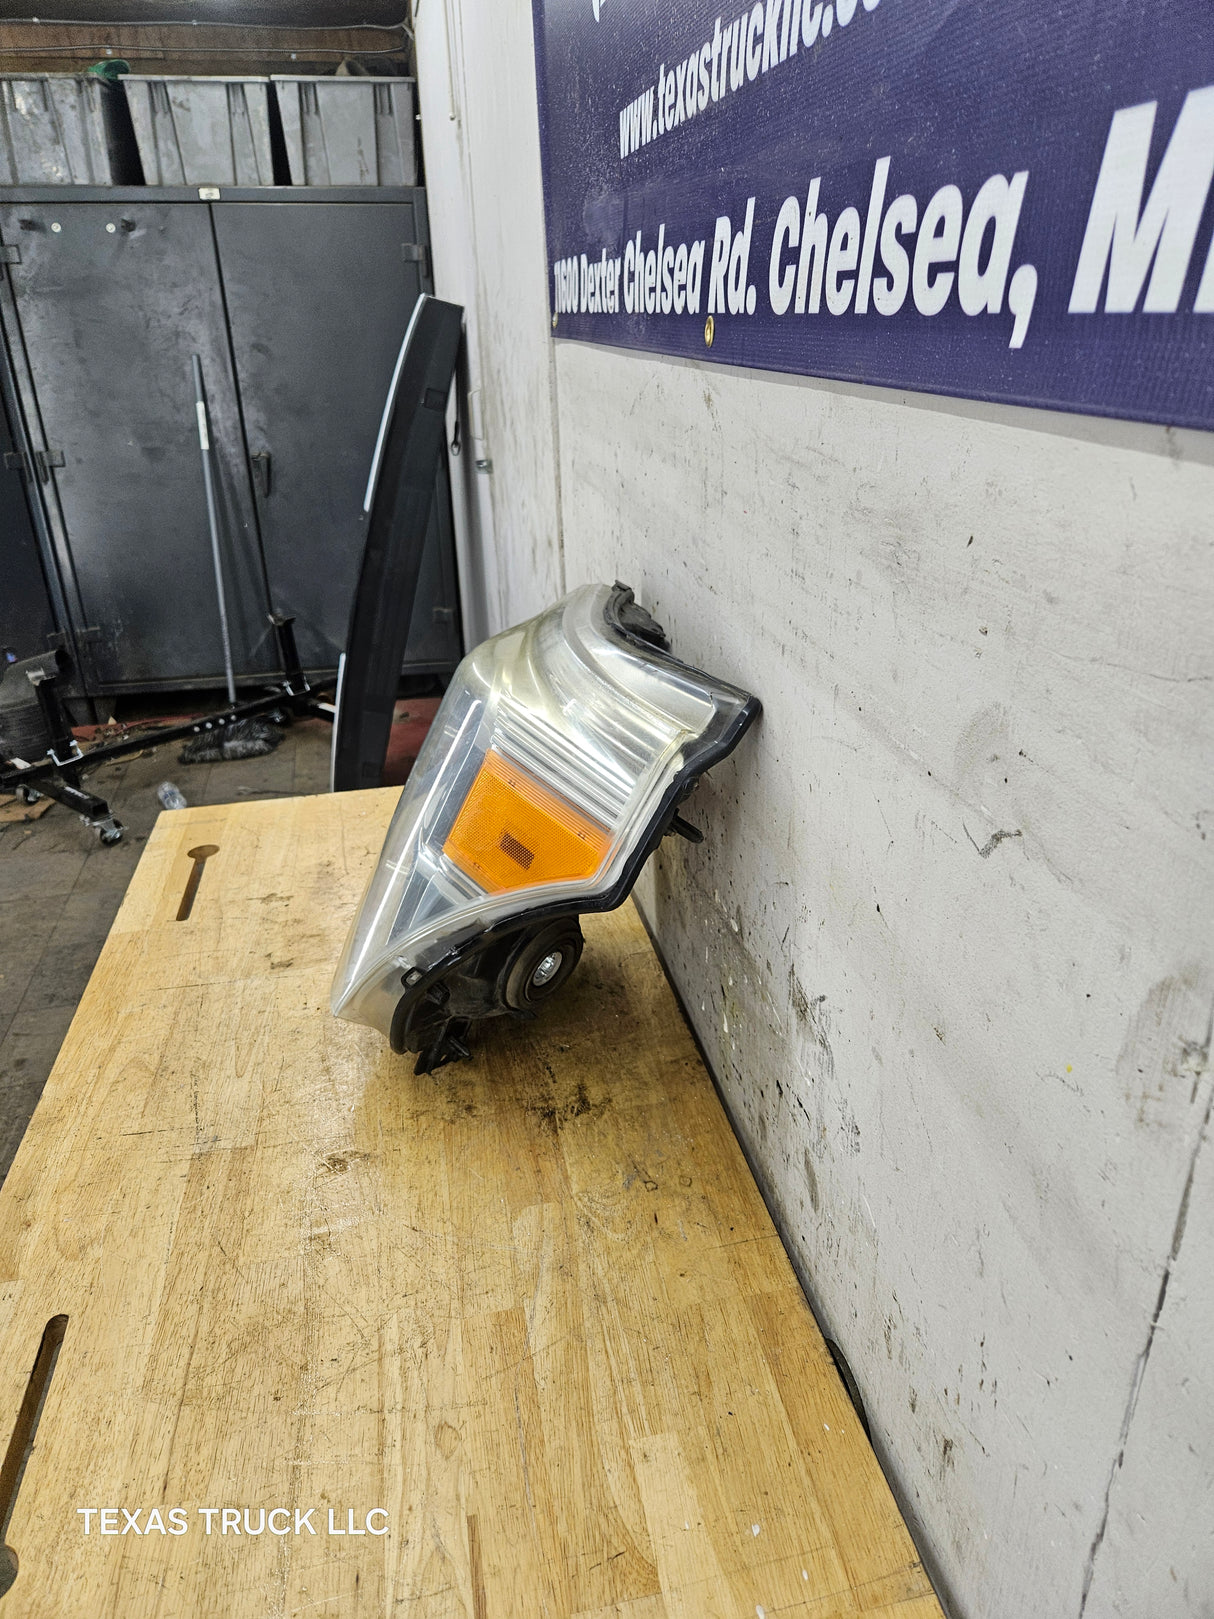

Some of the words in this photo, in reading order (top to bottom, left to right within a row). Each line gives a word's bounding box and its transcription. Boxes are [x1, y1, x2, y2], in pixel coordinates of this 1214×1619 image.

[619, 0, 881, 160] www.texastruckllc.
[580, 247, 622, 314] Dexter
[623, 223, 706, 315] Chelsea
[707, 197, 757, 315] Rd.
[769, 156, 1038, 349] Chelsea,
[1067, 84, 1214, 314] M
